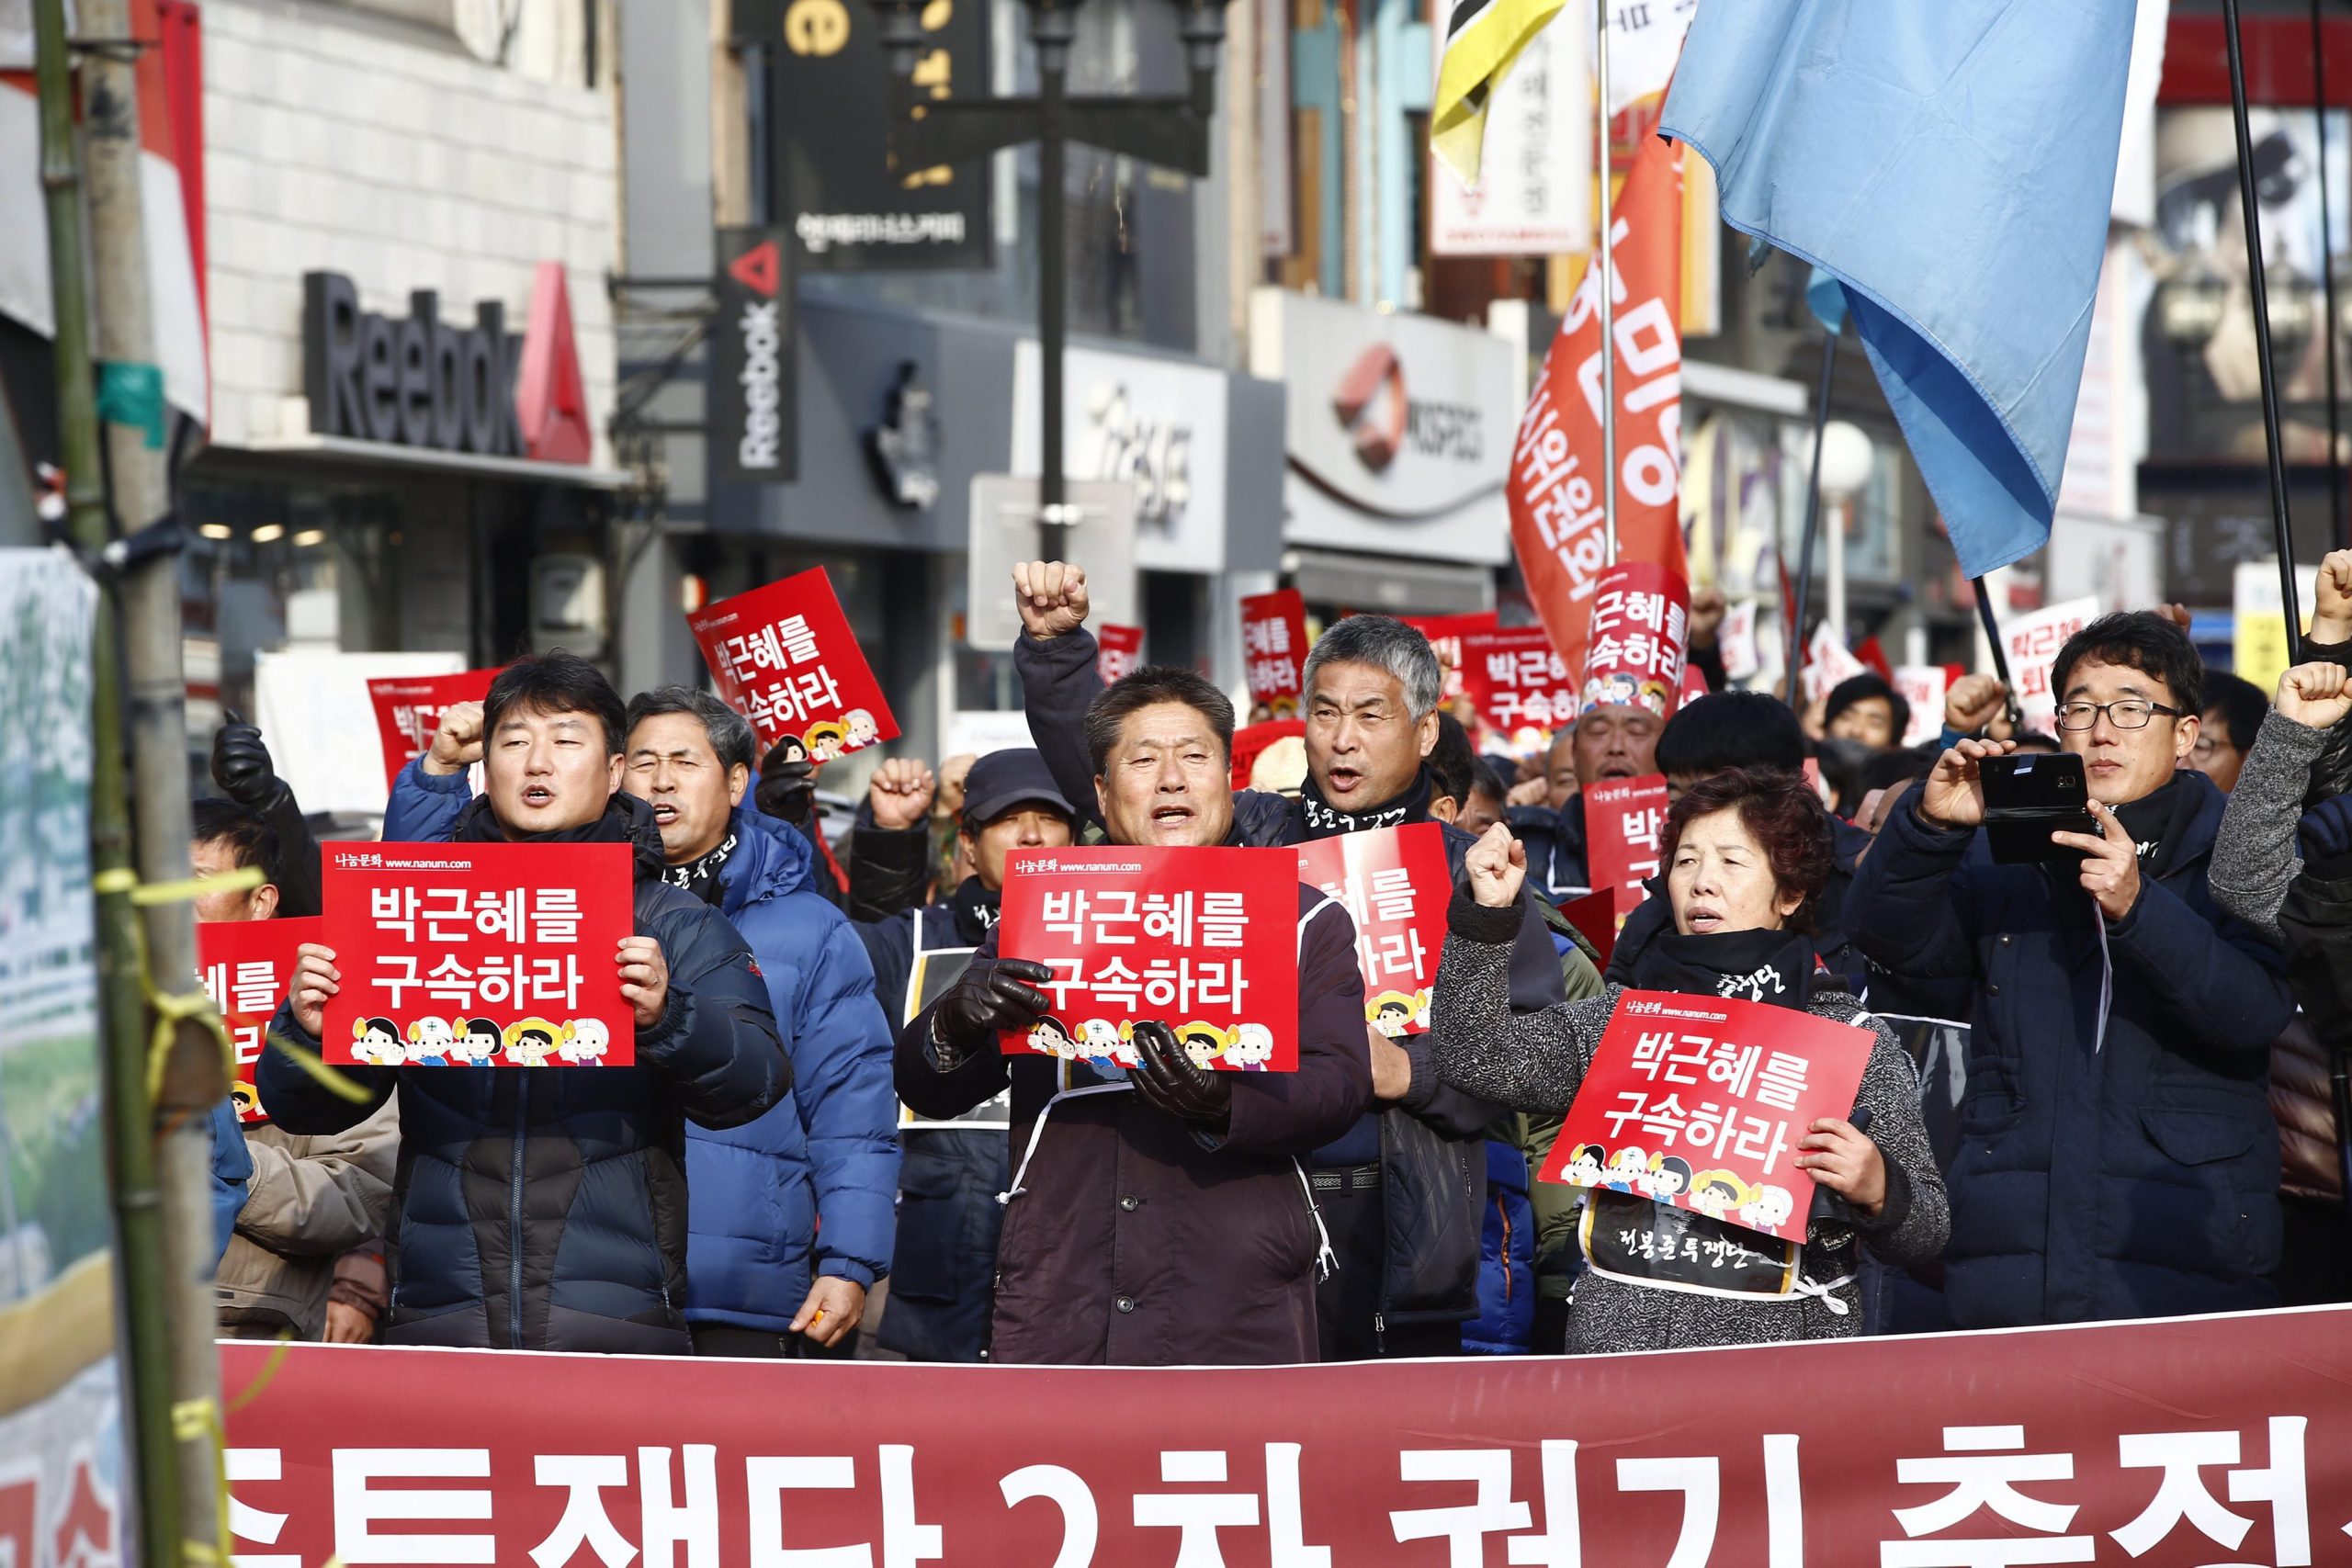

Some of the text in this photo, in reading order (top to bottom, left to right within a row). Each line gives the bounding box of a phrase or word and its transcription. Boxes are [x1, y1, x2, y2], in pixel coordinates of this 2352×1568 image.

[305, 272, 530, 459] Reebok
[738, 299, 780, 468] Reebok
[1517, 349, 1623, 602] 시위원회
[715, 615, 821, 685] 박근혜를
[1595, 591, 1686, 651] 근혜를
[1487, 650, 1567, 688] 박근
[1590, 634, 1687, 688] 속하라
[1489, 688, 1580, 728] 구속하
[334, 852, 471, 869] 나눔문화 www.nanum.com
[1014, 858, 1142, 874] 나눔문화 www.nanum.com
[371, 886, 583, 944] 박근혜를
[1042, 888, 1250, 948] 박근혜를
[1319, 866, 1418, 926] 혜를
[371, 953, 584, 1010] 구속하라
[1035, 955, 1250, 1015] 구속하라
[1625, 999, 1727, 1021] 나눔문화 www.nanum.com
[1630, 1032, 1809, 1111] 박근혜를
[1603, 1090, 1788, 1177] 구속하라
[1619, 1227, 1748, 1269] 전봉준투쟁단
[998, 1443, 1332, 1568] 2차
